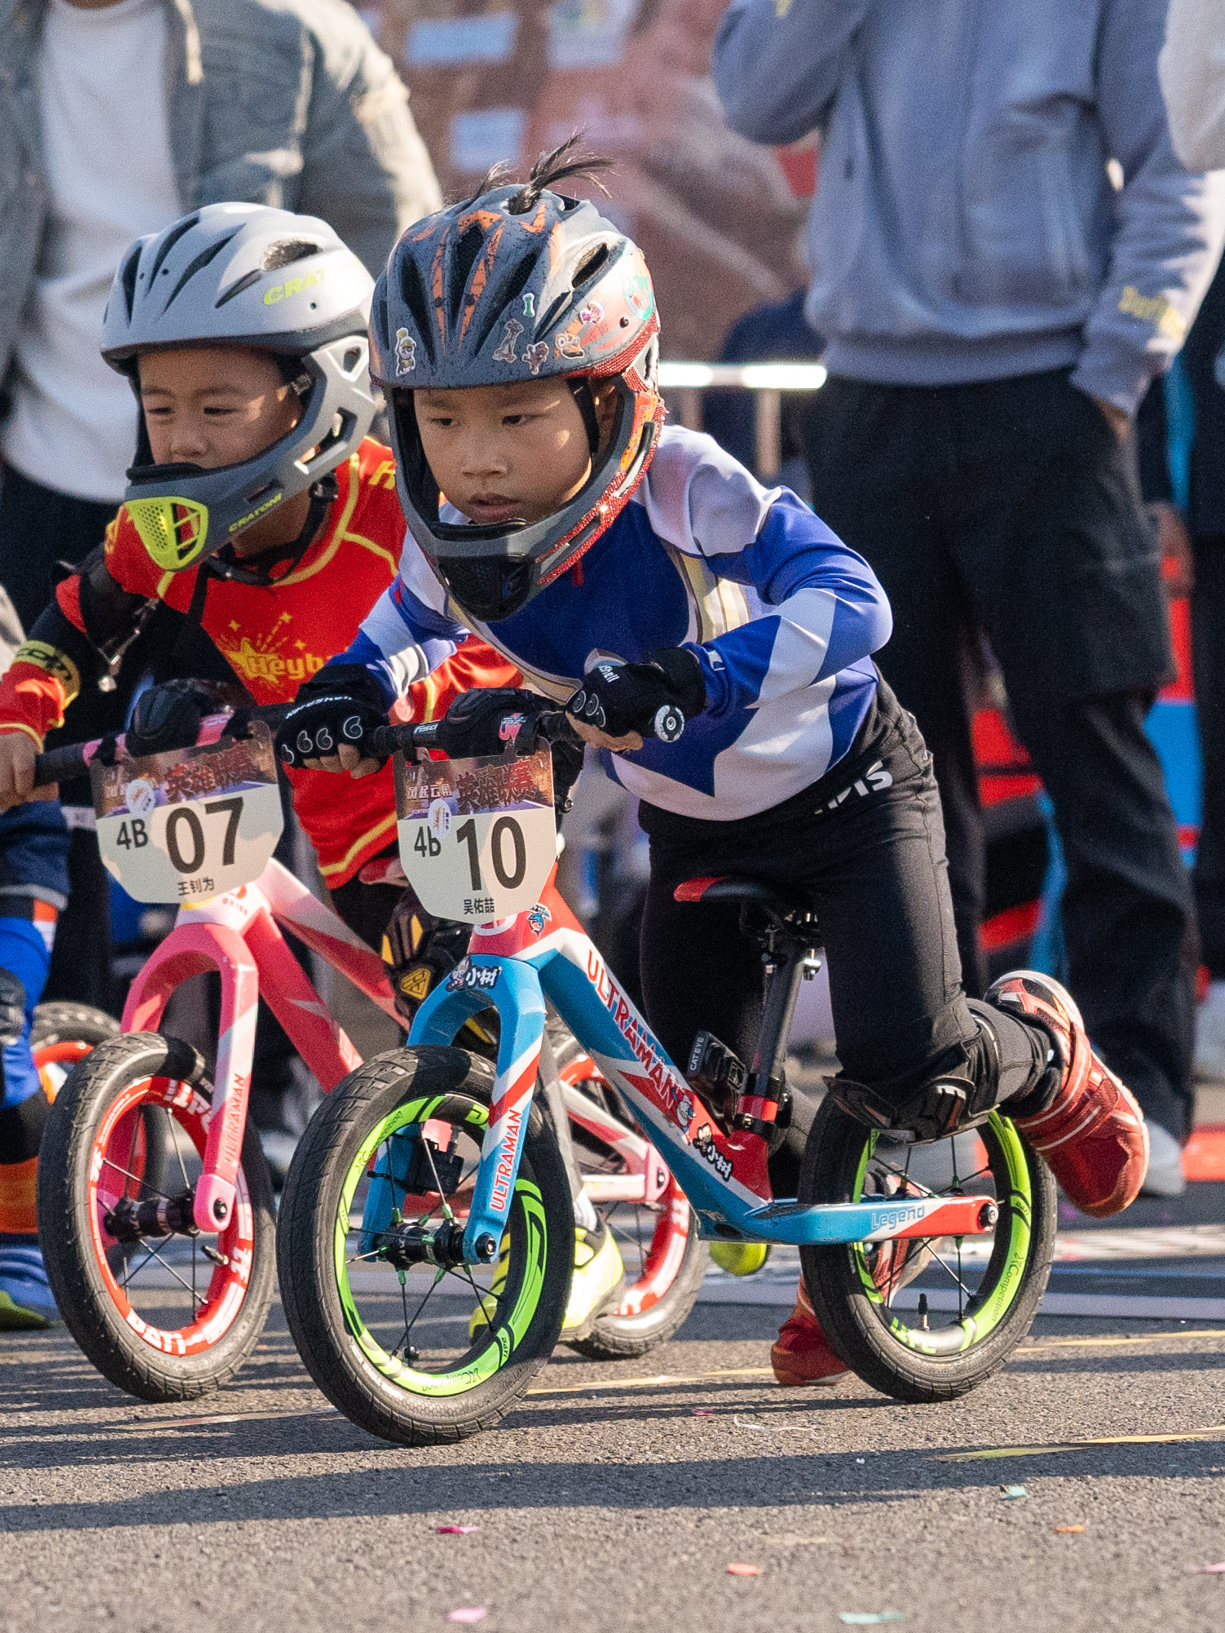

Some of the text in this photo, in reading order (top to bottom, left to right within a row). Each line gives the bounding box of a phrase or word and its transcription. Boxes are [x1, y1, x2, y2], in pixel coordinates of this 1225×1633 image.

[228, 493, 282, 532] CRATONI
[116, 797, 244, 875] 4B 07
[456, 816, 526, 891] 10
[178, 877, 215, 896] 王钊为
[465, 966, 498, 987] 小树
[587, 948, 686, 1110] ULTRAMAN
[224, 1073, 245, 1163] ULTRAMAN
[491, 1108, 522, 1211] ULTRAMAN
[706, 1144, 733, 1182] 小树
[870, 1205, 926, 1230] Legend
